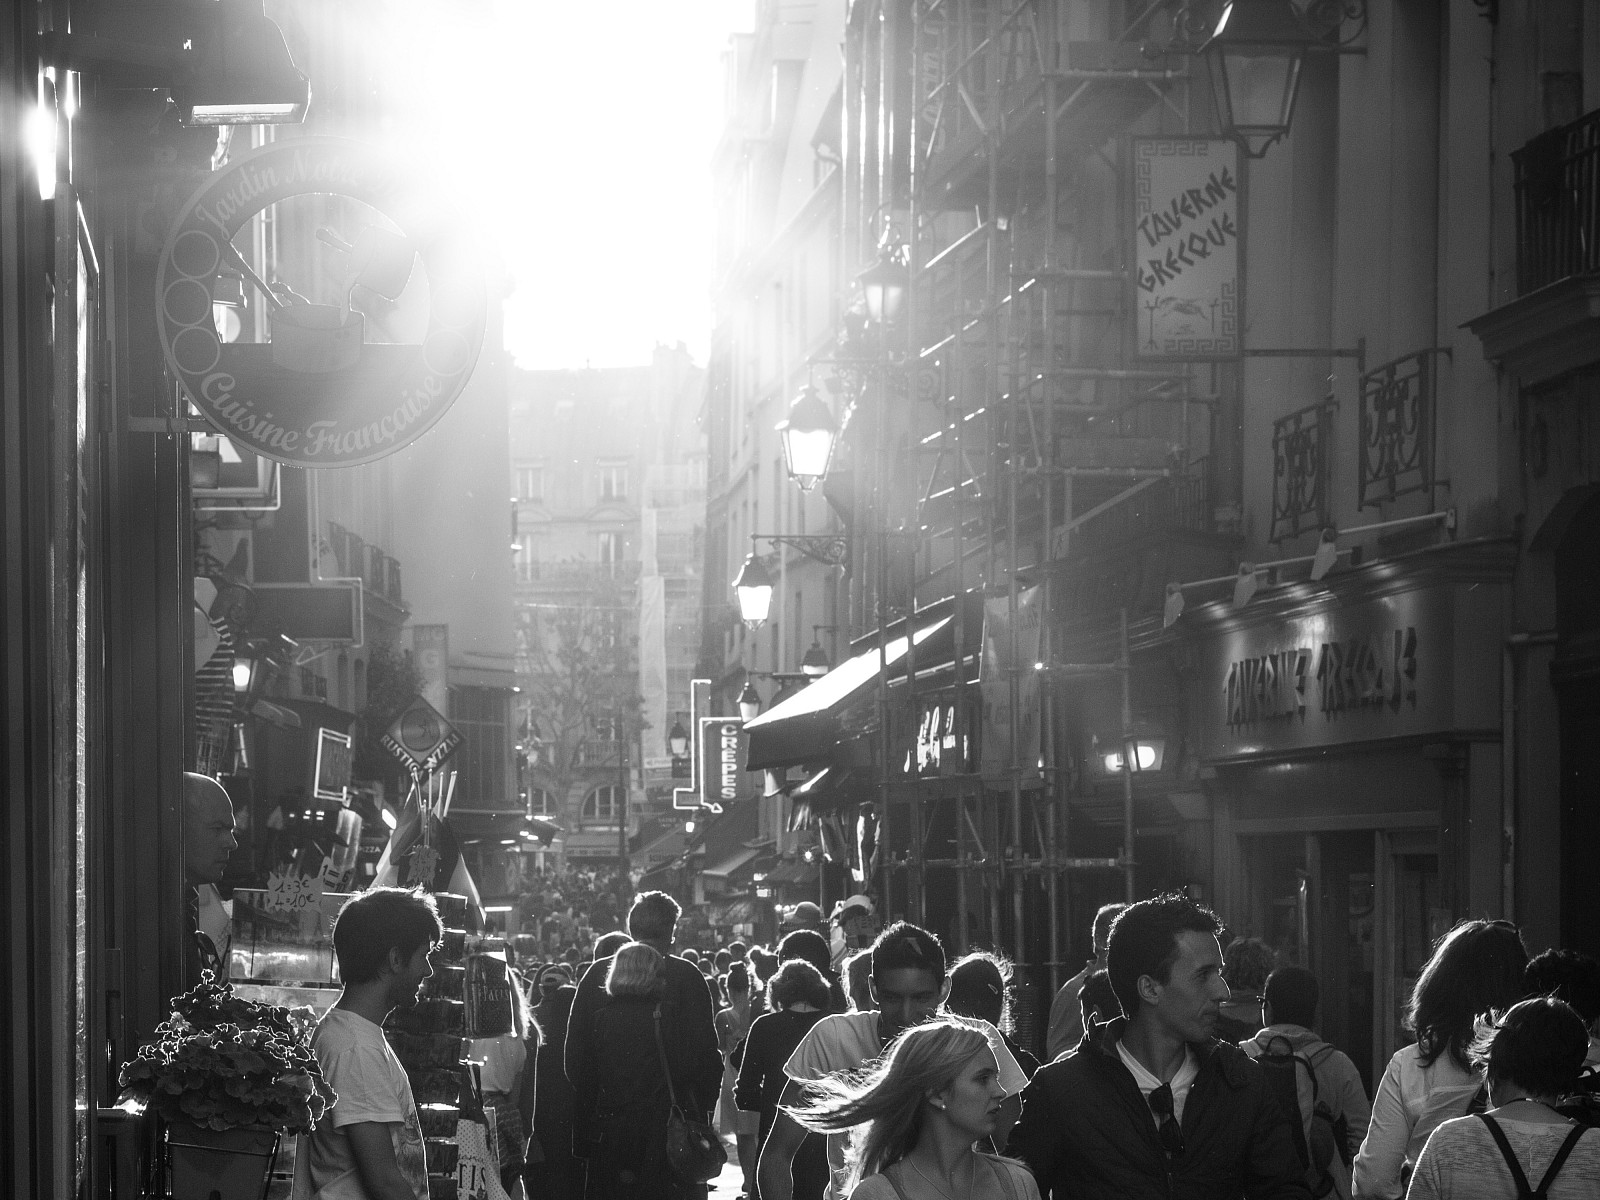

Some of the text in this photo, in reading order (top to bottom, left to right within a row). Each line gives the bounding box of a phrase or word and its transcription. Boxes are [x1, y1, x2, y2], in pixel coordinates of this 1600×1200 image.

[194, 166, 280, 240] Jardin
[1137, 165, 1237, 247] TAVERNE
[1137, 212, 1237, 293] GRECQUE
[200, 372, 443, 456] Cuisine Française
